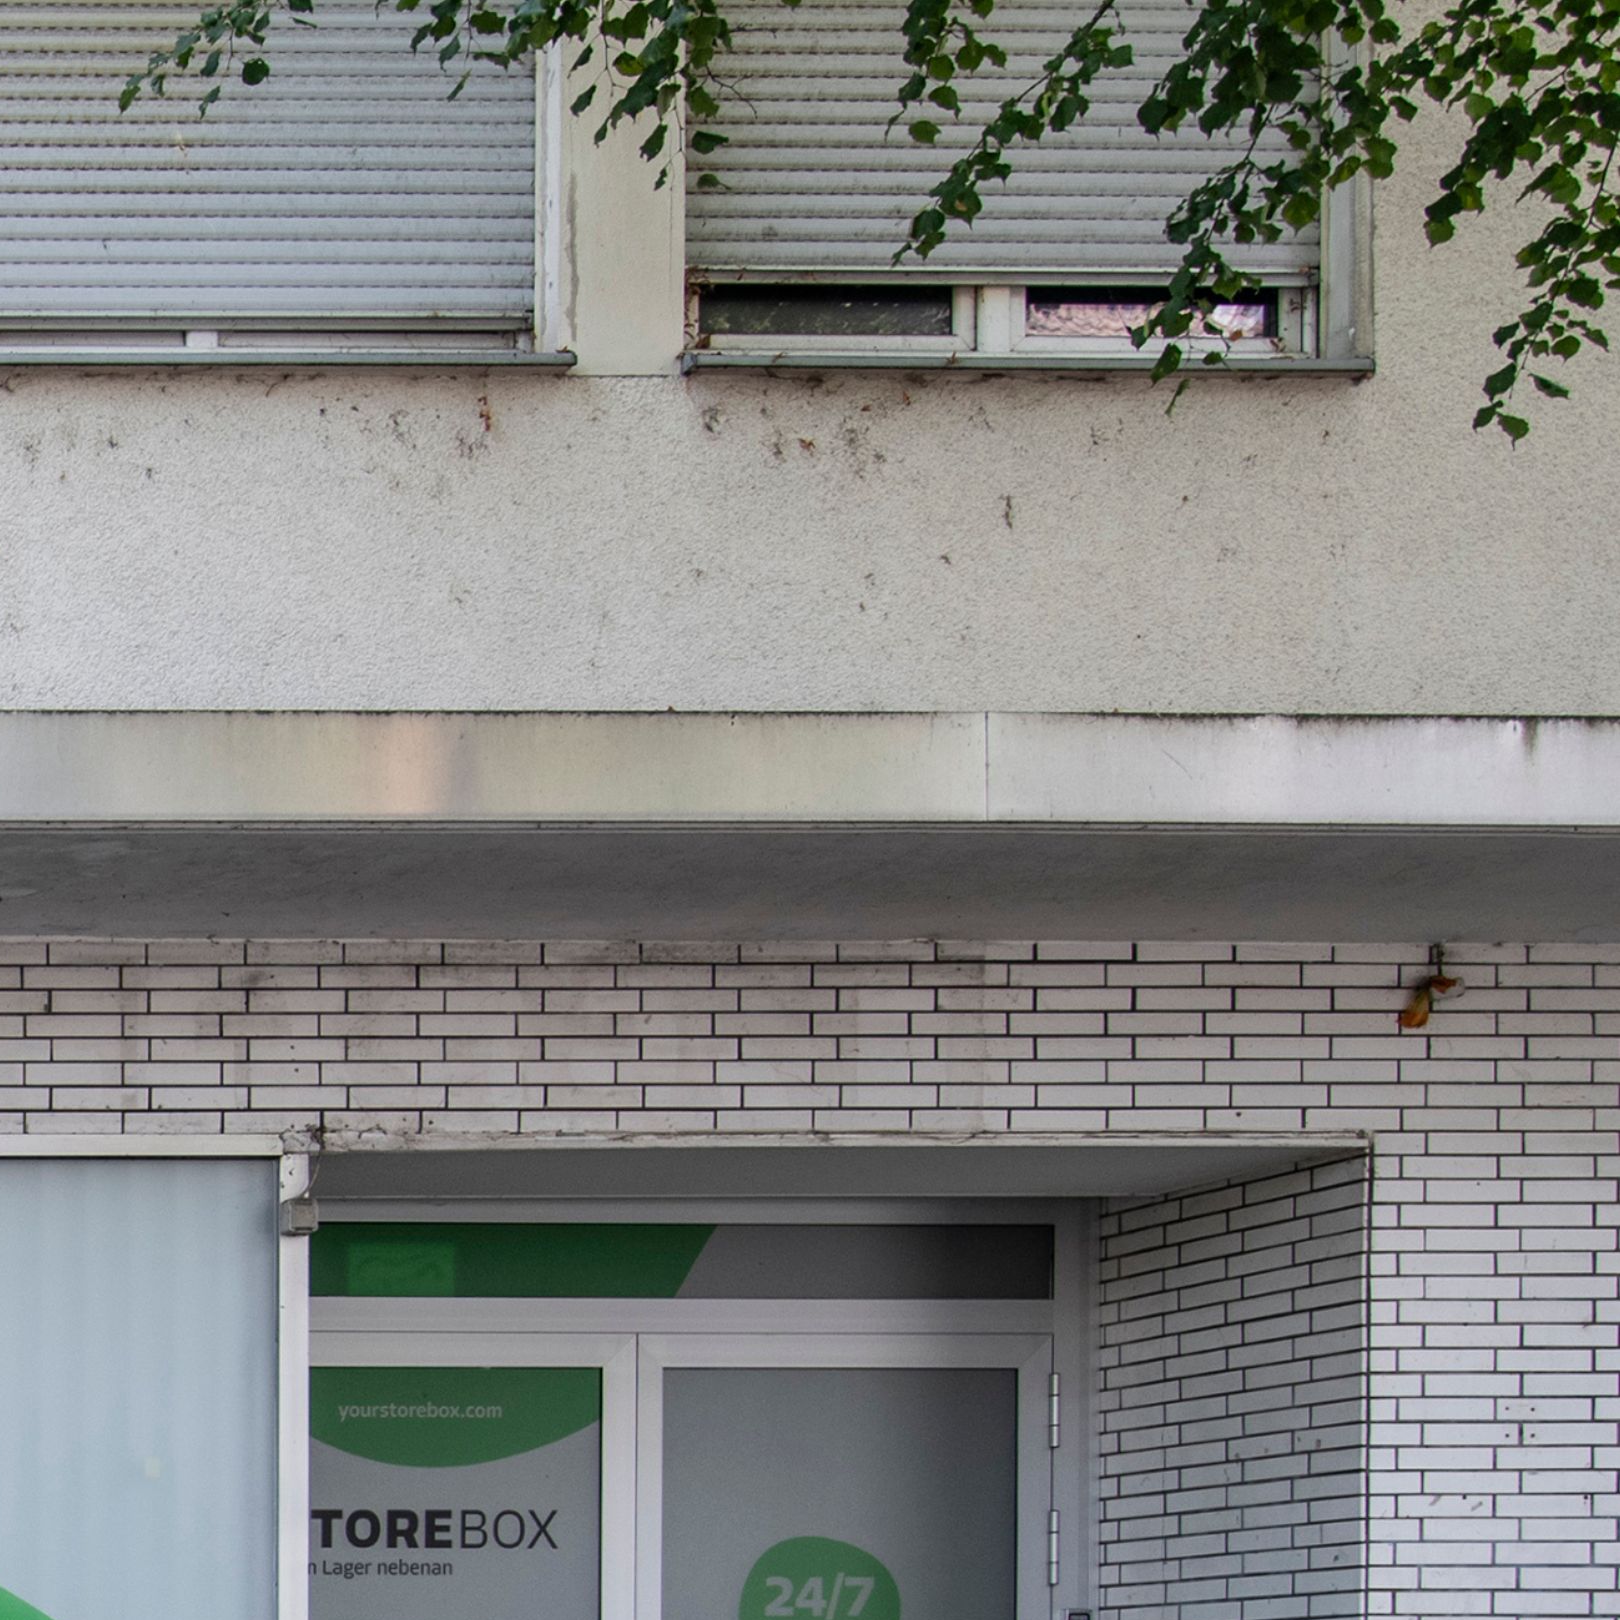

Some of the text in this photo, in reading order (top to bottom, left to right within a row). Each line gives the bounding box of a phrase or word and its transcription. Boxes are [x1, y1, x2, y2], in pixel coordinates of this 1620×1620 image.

[337, 1402, 504, 1422] yourstorebox.com
[310, 1508, 558, 1549] TOREBOX
[322, 1560, 372, 1580] Lager
[377, 1559, 453, 1575] nebenan
[764, 1572, 875, 1620] 24/7
